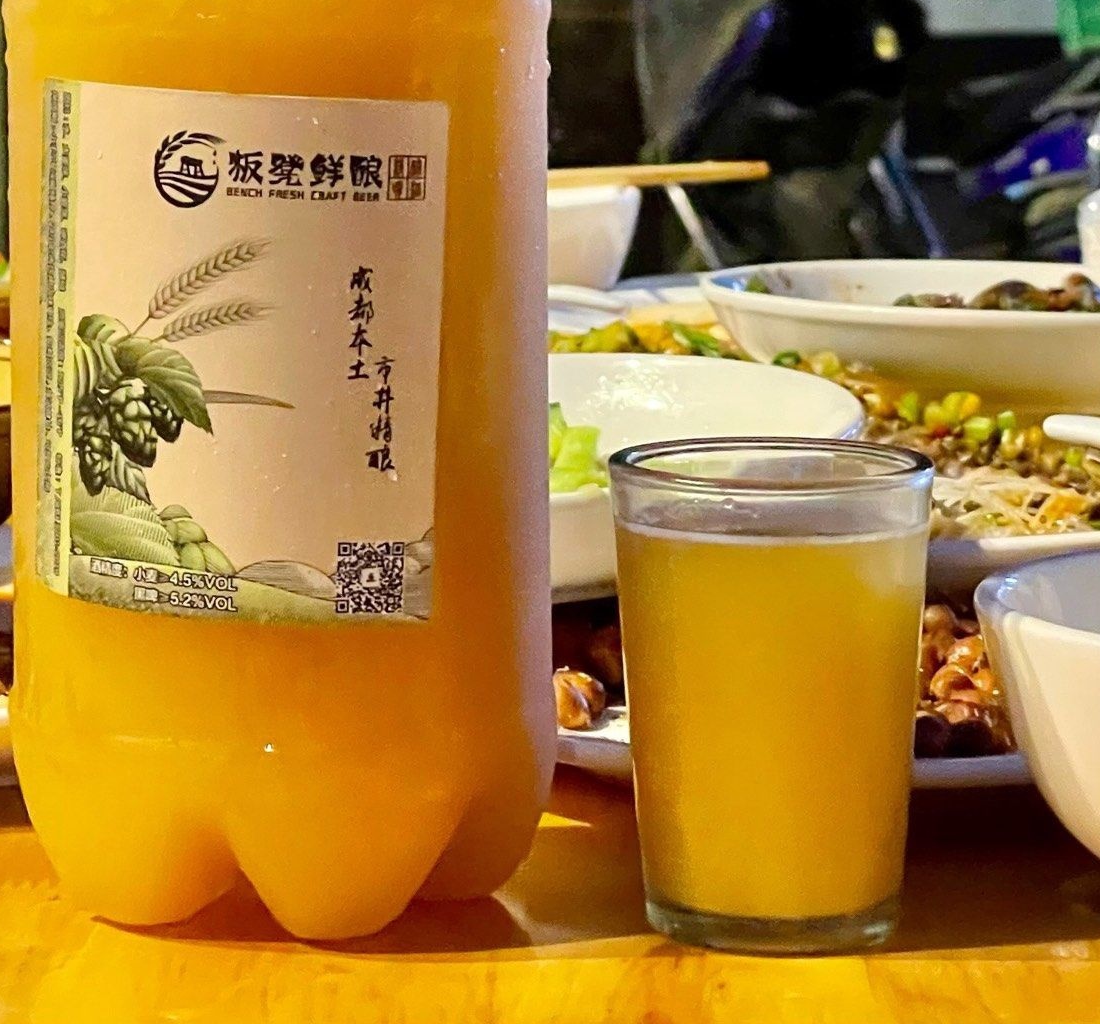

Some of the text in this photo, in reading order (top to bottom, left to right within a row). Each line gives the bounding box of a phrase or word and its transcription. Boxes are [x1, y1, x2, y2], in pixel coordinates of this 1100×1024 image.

[228, 149, 383, 189] 板凳鲜酿
[226, 187, 380, 202] BENCH FRESH CRAFT BEER
[348, 265, 374, 380] 成都本土
